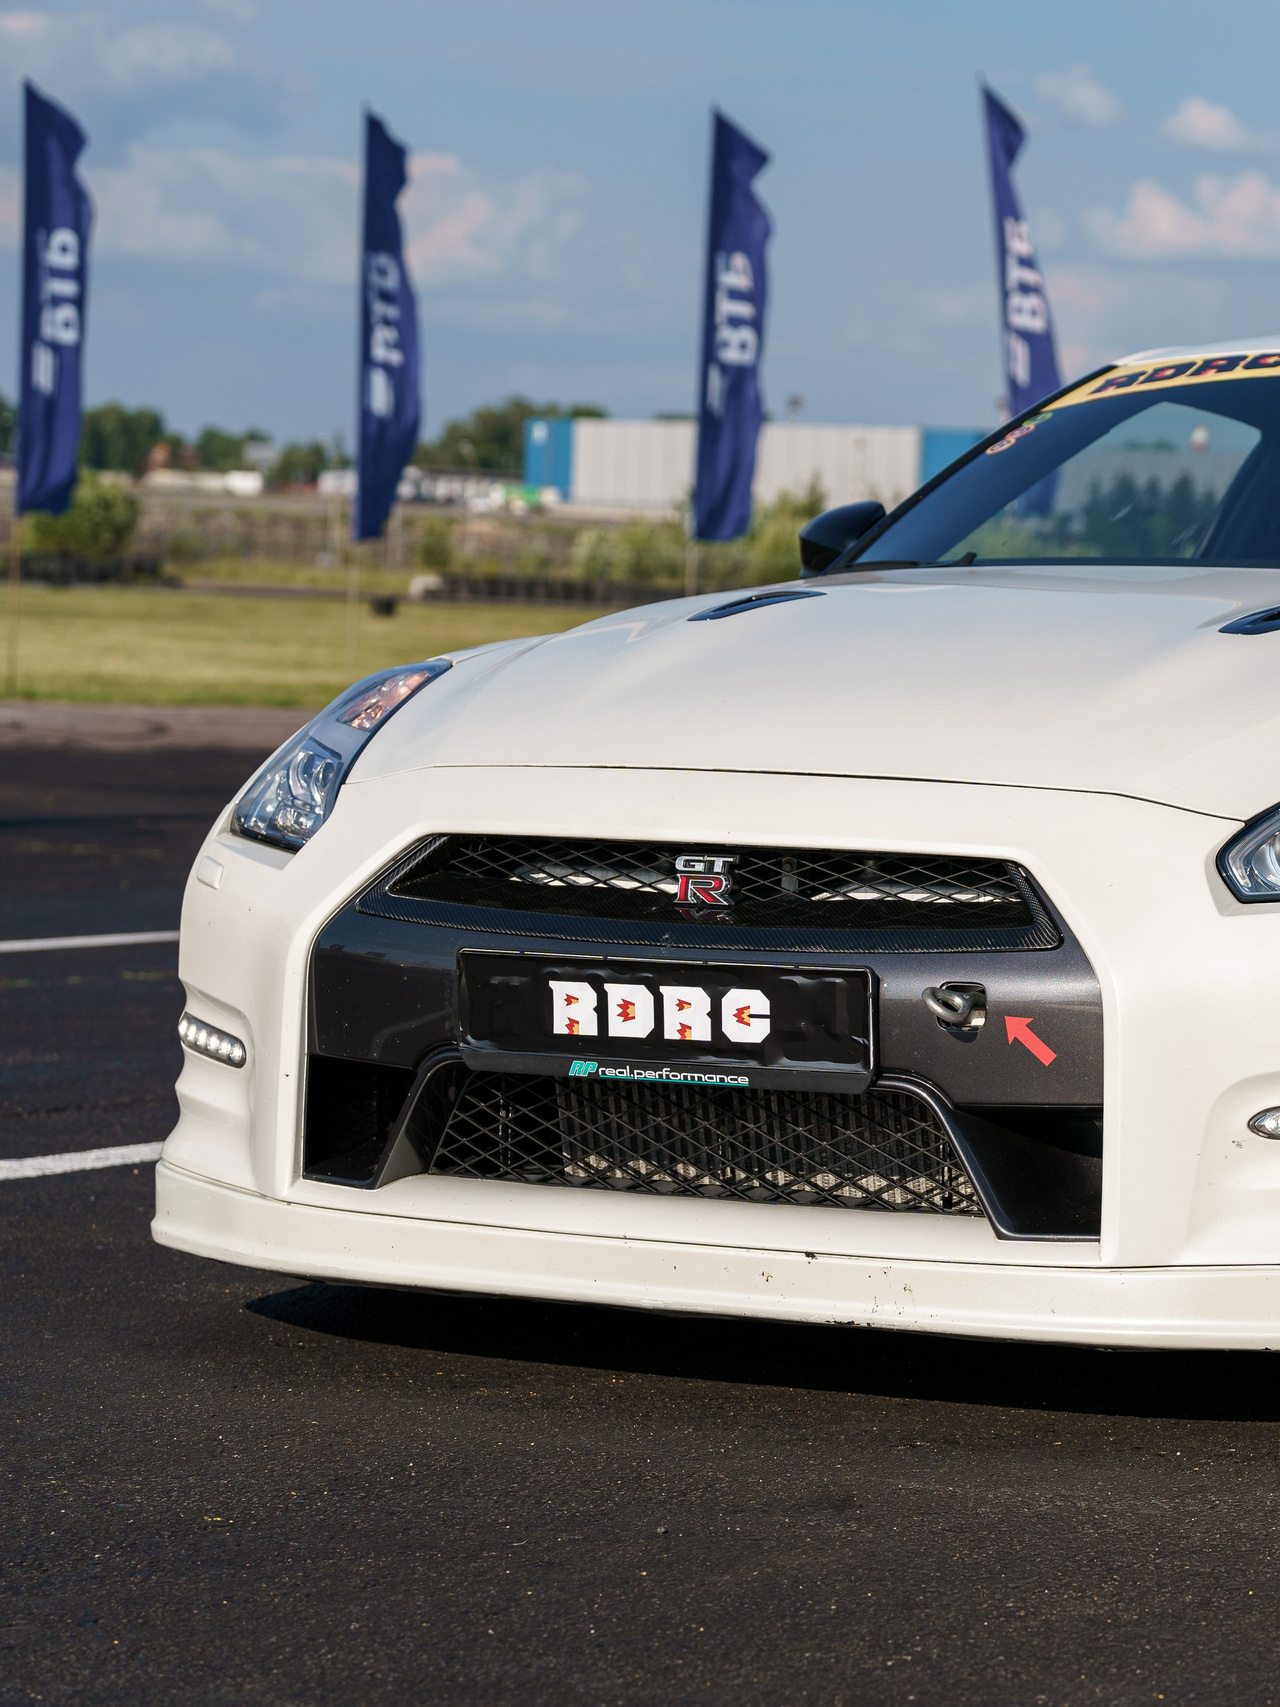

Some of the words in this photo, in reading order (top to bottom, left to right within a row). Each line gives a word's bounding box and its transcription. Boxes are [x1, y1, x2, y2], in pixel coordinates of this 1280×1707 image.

[549, 980, 770, 1043] RDRC
[569, 1060, 598, 1076] RP
[598, 1065, 749, 1084] real.performance
